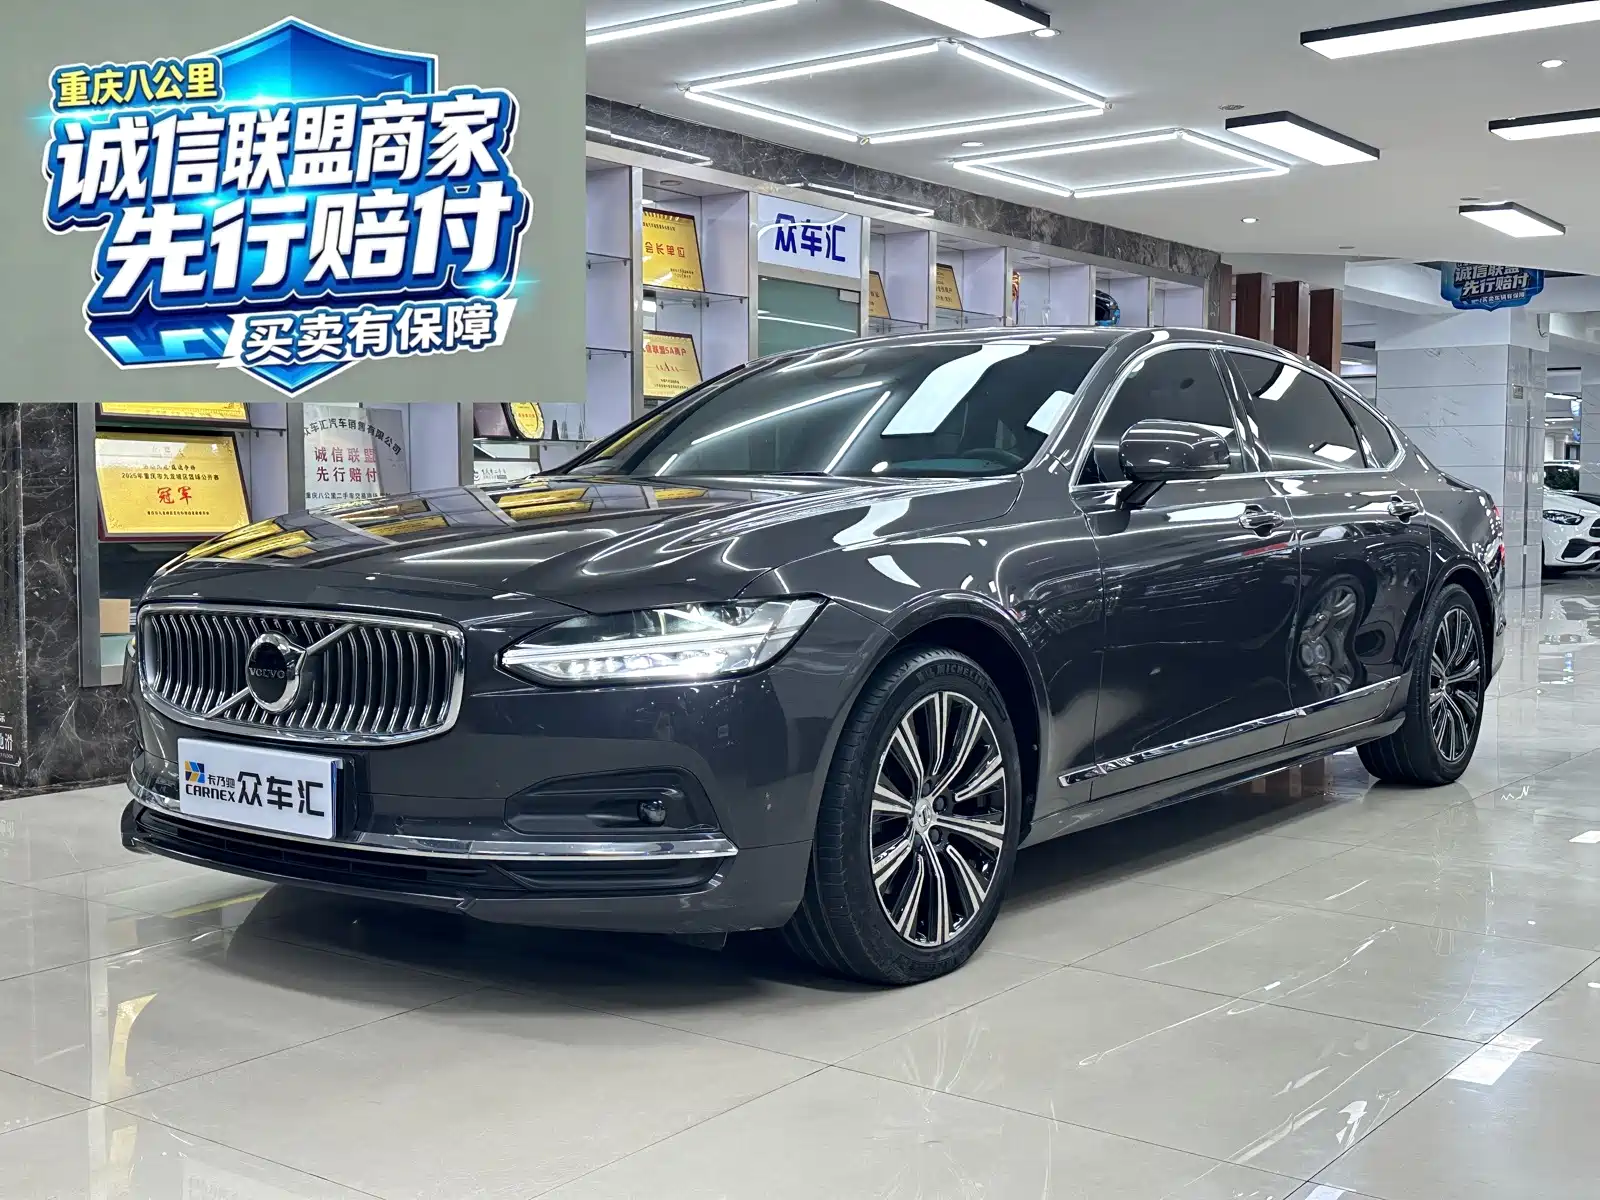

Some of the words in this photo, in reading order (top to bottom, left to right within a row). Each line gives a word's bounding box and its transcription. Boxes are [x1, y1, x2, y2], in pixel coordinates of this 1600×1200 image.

[774, 213, 847, 262] 众车汇
[645, 241, 686, 258] 会长单位
[1462, 272, 1530, 296] 先行赔付
[314, 446, 377, 463] 诚信联盟
[316, 466, 378, 483] 先行赔付
[156, 485, 193, 505] 冠军
[248, 667, 286, 679] VOLVO
[936, 664, 989, 690] MICHELIN
[207, 774, 236, 789] 卡乃驰
[185, 784, 236, 803] CARNEX
[237, 771, 325, 817] 众车汇
